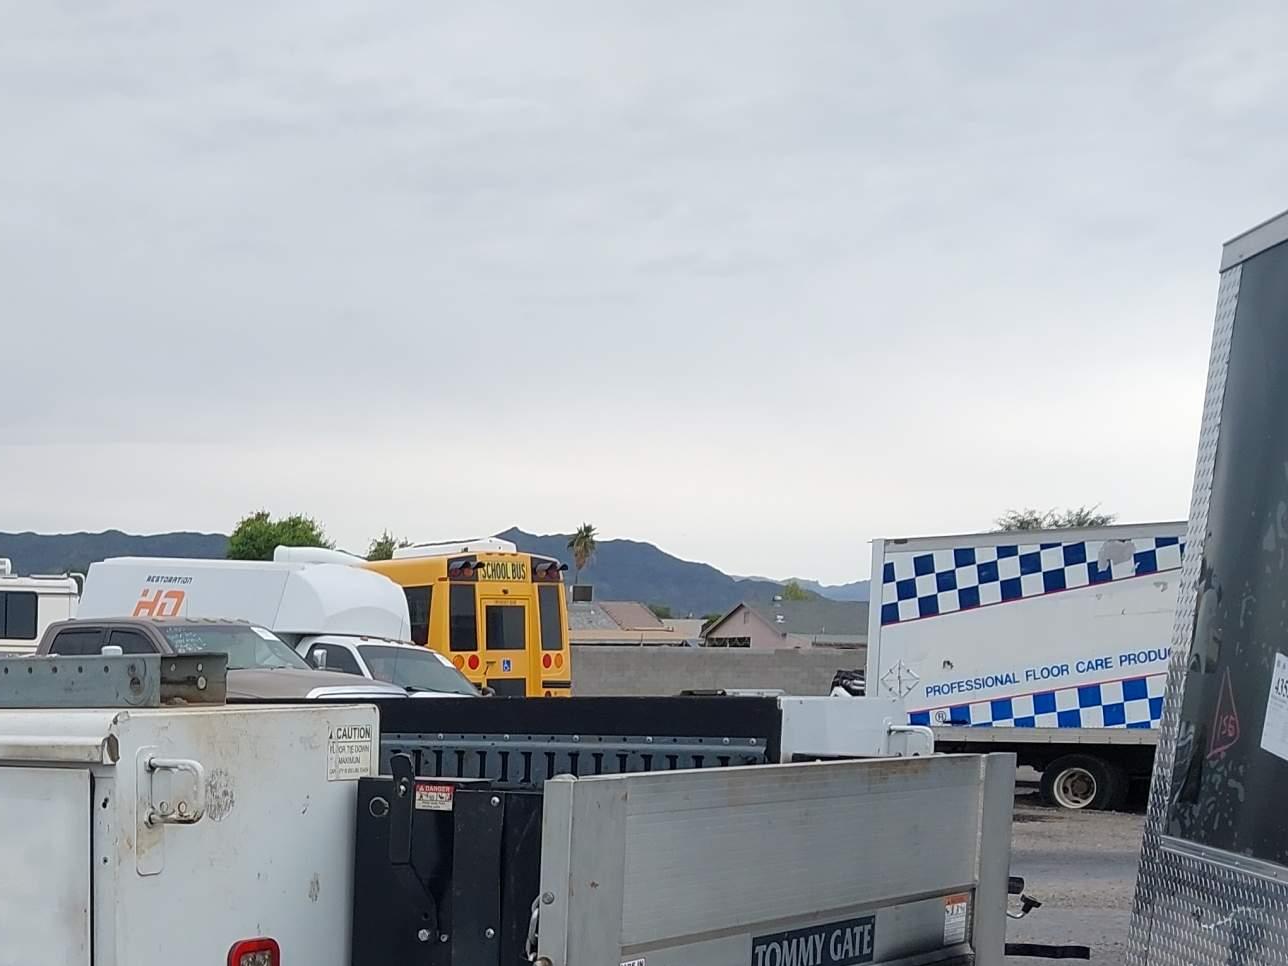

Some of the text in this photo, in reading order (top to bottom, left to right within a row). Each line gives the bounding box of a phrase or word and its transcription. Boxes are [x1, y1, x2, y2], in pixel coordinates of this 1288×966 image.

[482, 562, 526, 579] SCHOOL BUS
[132, 588, 185, 617] HD
[925, 672, 1020, 698] PROFESSIONAL
[1024, 663, 1071, 682] FLOOR
[1075, 657, 1113, 674] CARE
[336, 727, 371, 740] CAUTION
[425, 785, 451, 793] DANGER
[830, 924, 873, 961] GATE
